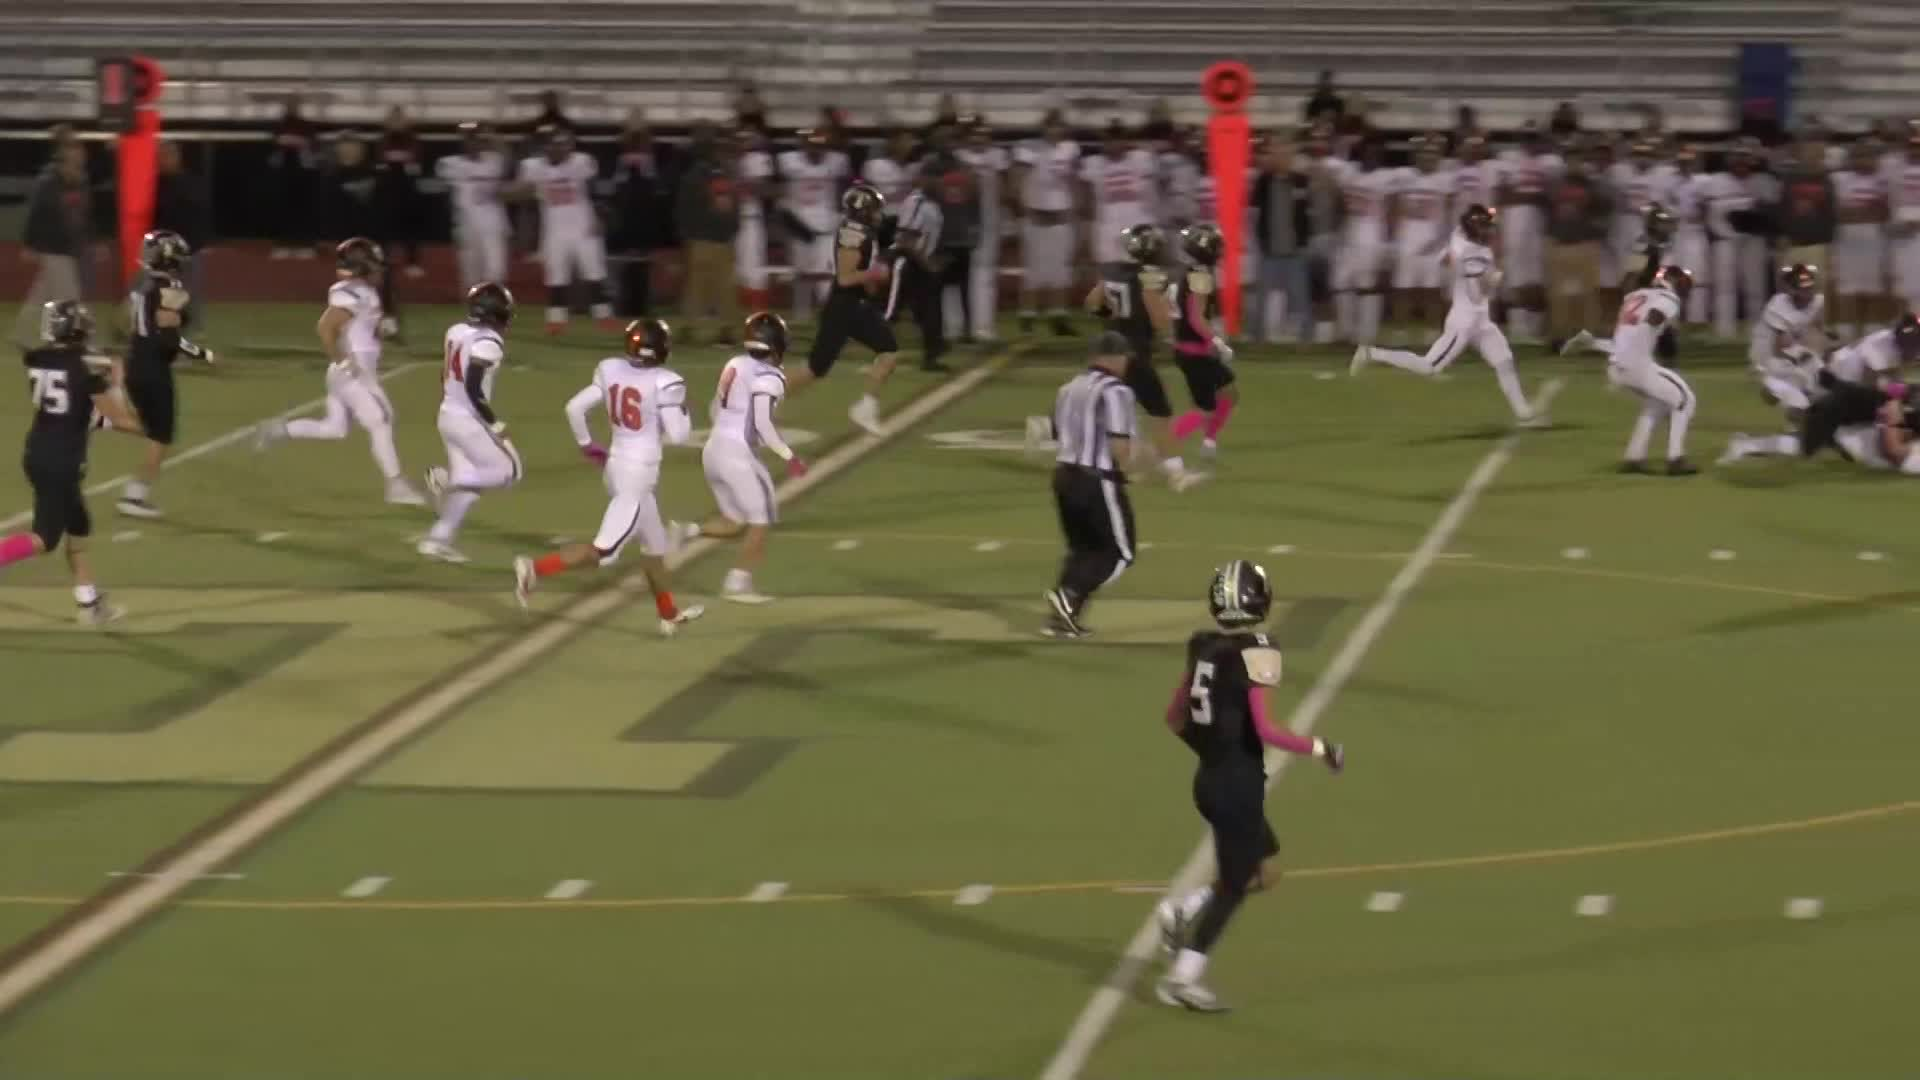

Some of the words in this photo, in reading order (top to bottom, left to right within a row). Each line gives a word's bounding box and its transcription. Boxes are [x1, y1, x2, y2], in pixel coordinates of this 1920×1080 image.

[28, 367, 69, 415] 75
[608, 383, 642, 432] 16
[1190, 660, 1215, 726] 5
